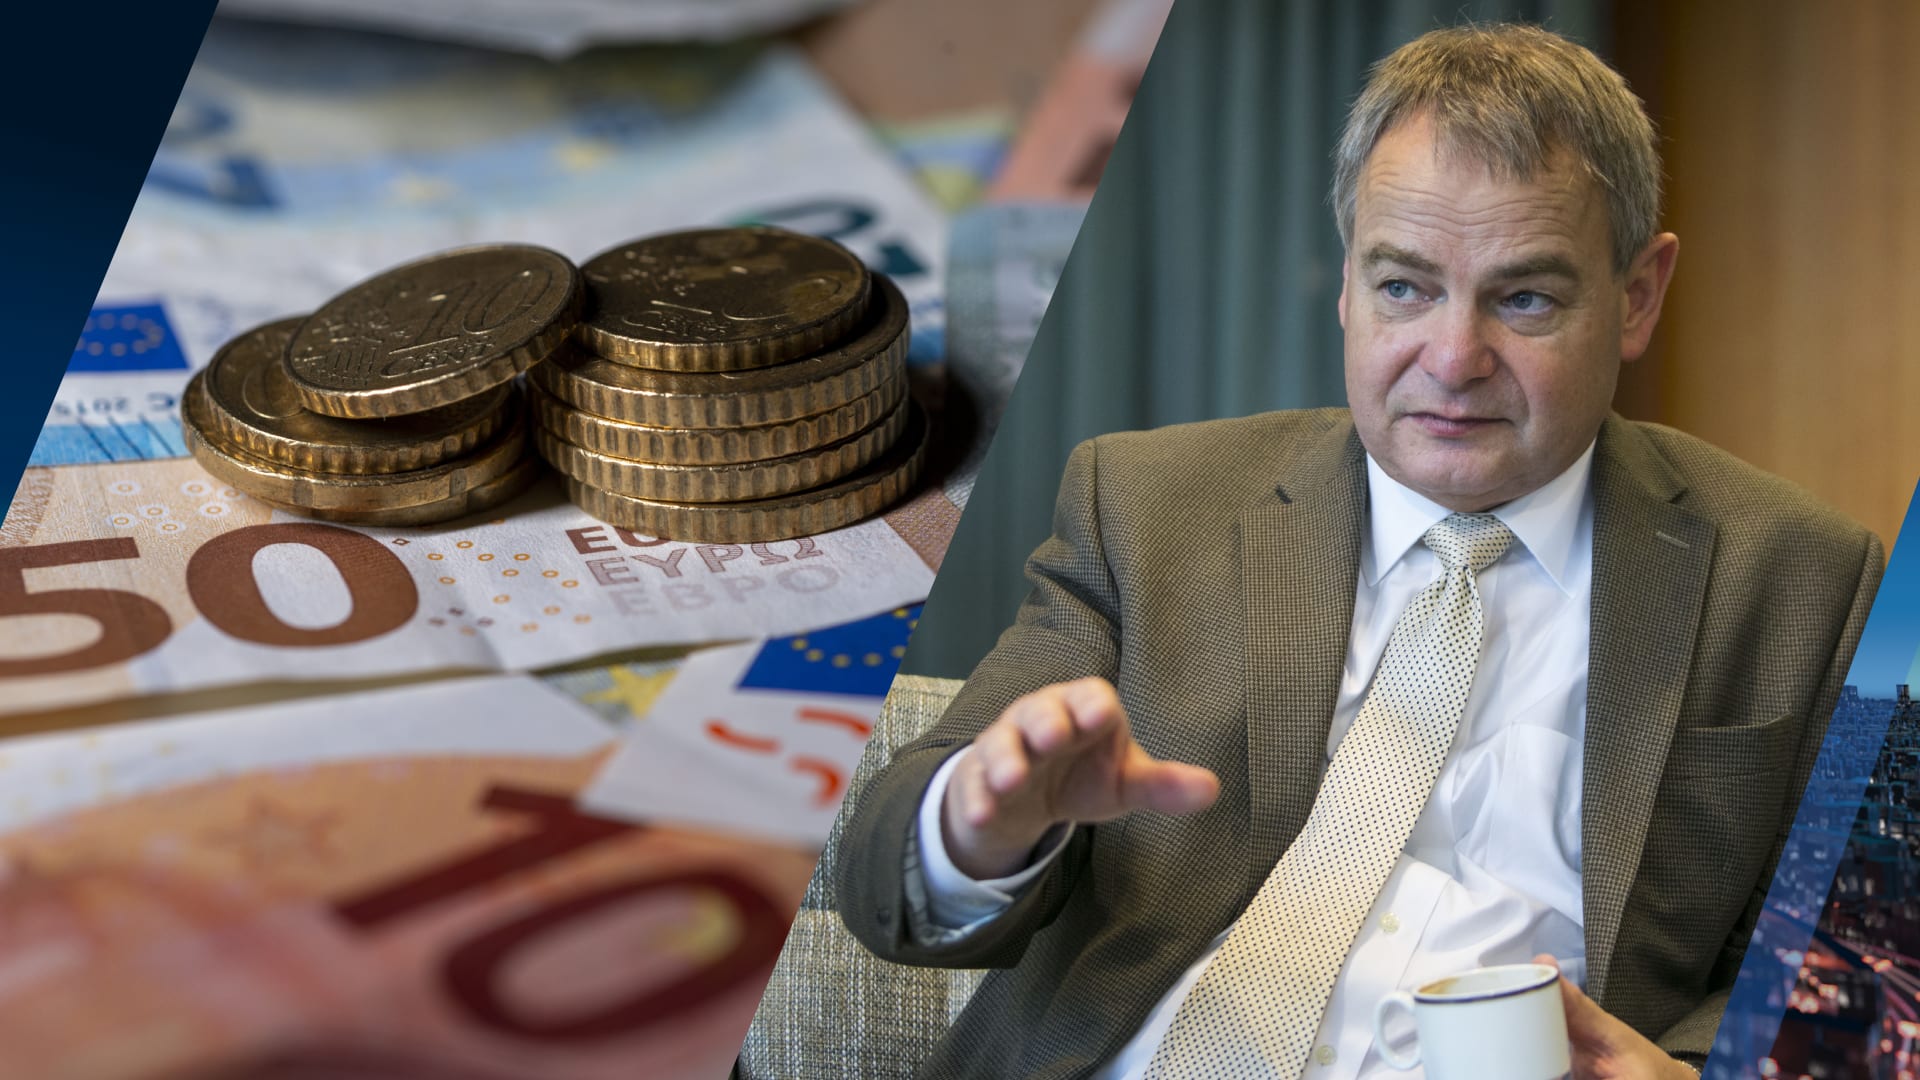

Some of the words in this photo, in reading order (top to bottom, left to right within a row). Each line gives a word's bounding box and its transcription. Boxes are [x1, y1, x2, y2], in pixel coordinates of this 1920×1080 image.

[0, 523, 418, 677] 50
[565, 525, 673, 555] EU
[330, 780, 795, 1044] 10
